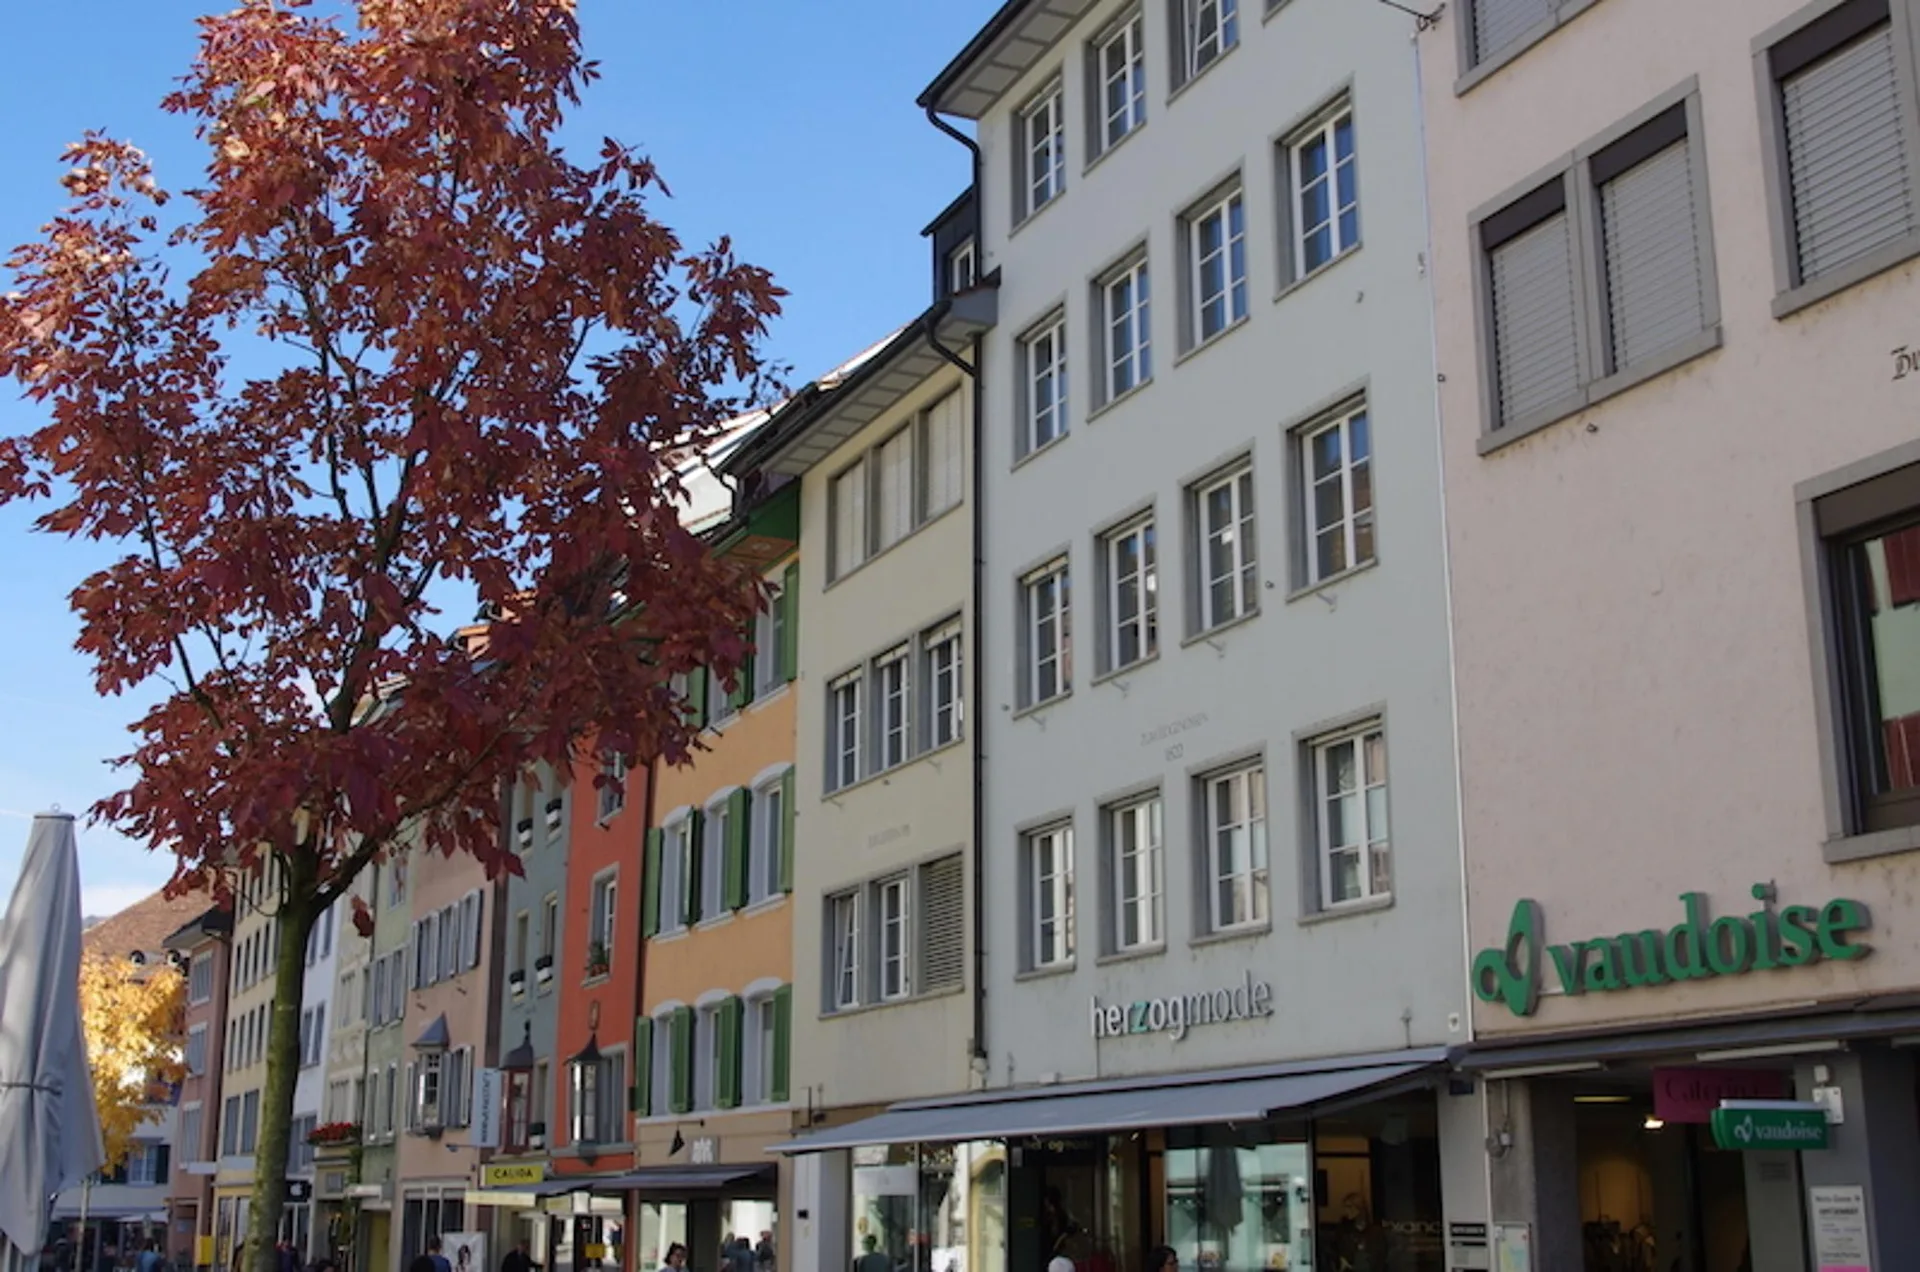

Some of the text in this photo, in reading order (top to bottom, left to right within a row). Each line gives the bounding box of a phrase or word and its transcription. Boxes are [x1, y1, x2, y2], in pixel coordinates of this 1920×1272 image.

[1547, 882, 1871, 996] vaudoise
[1090, 969, 1274, 1041] herzogmode
[1756, 1119, 1823, 1140] vaudoise
[493, 1167, 534, 1180] CALIDA
